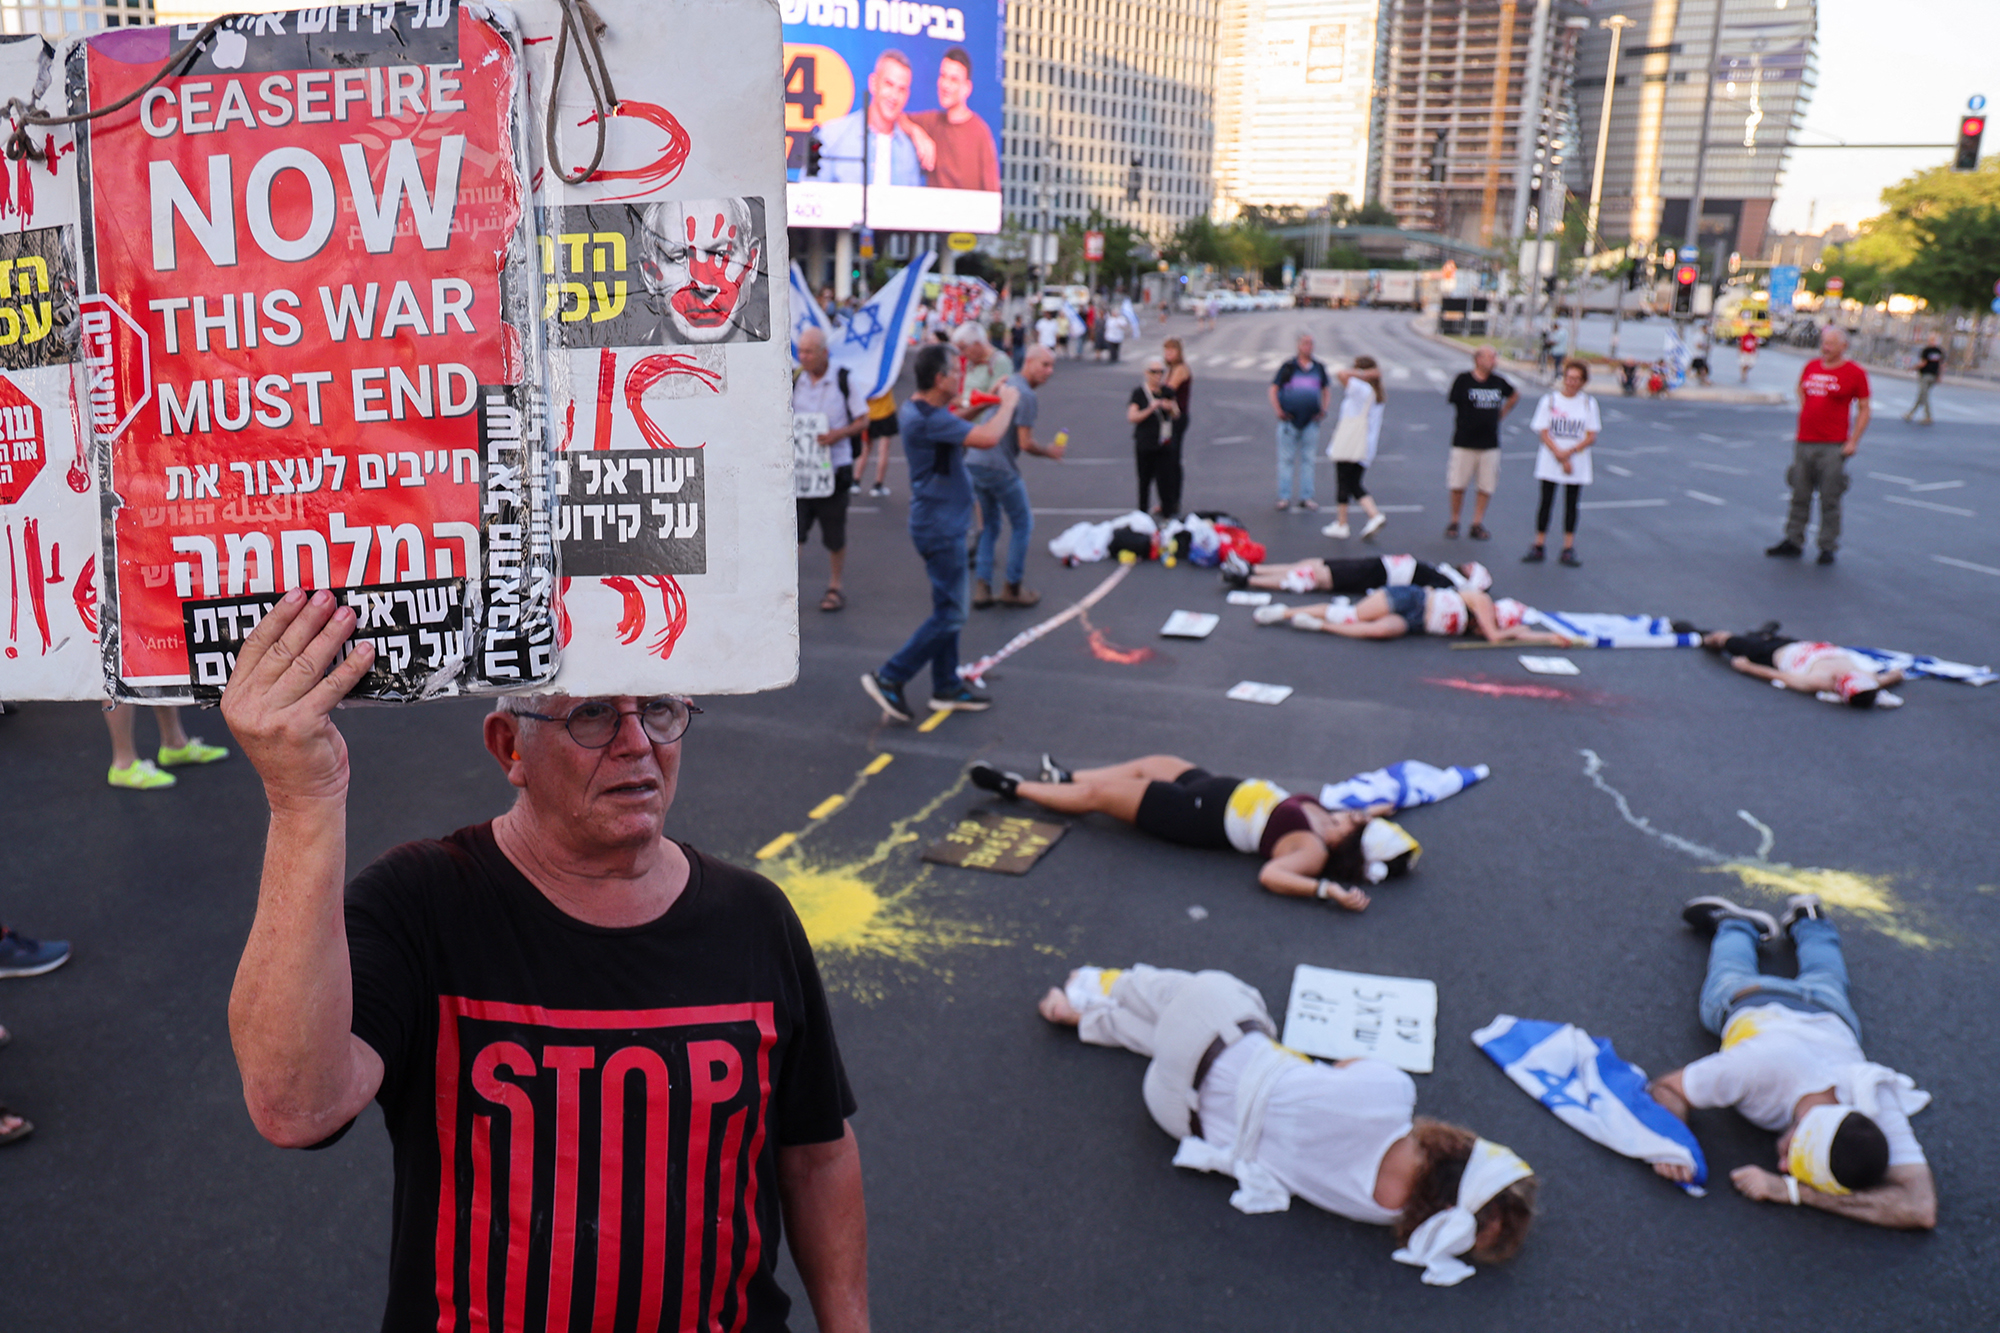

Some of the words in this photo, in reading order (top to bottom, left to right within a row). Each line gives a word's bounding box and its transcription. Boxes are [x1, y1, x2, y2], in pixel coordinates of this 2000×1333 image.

[864, 0, 966, 42] בביטוח
[140, 60, 466, 138] CEASEFIRE
[149, 134, 467, 272] NOW
[149, 288, 303, 355] THIS
[318, 278, 477, 342] WAR
[158, 370, 334, 436] MUST
[351, 362, 479, 422] END
[12, 440, 39, 462] את
[230, 447, 346, 497] לעצור
[357, 447, 481, 490] חייבים
[484, 395, 522, 514] ישראל
[579, 454, 695, 496] ישראל
[165, 463, 221, 500] את
[651, 498, 699, 540] על
[172, 511, 481, 599] המלחמה
[346, 586, 458, 630] ישראל
[484, 523, 523, 678] מתאבדת
[471, 1039, 744, 1106] STOP
